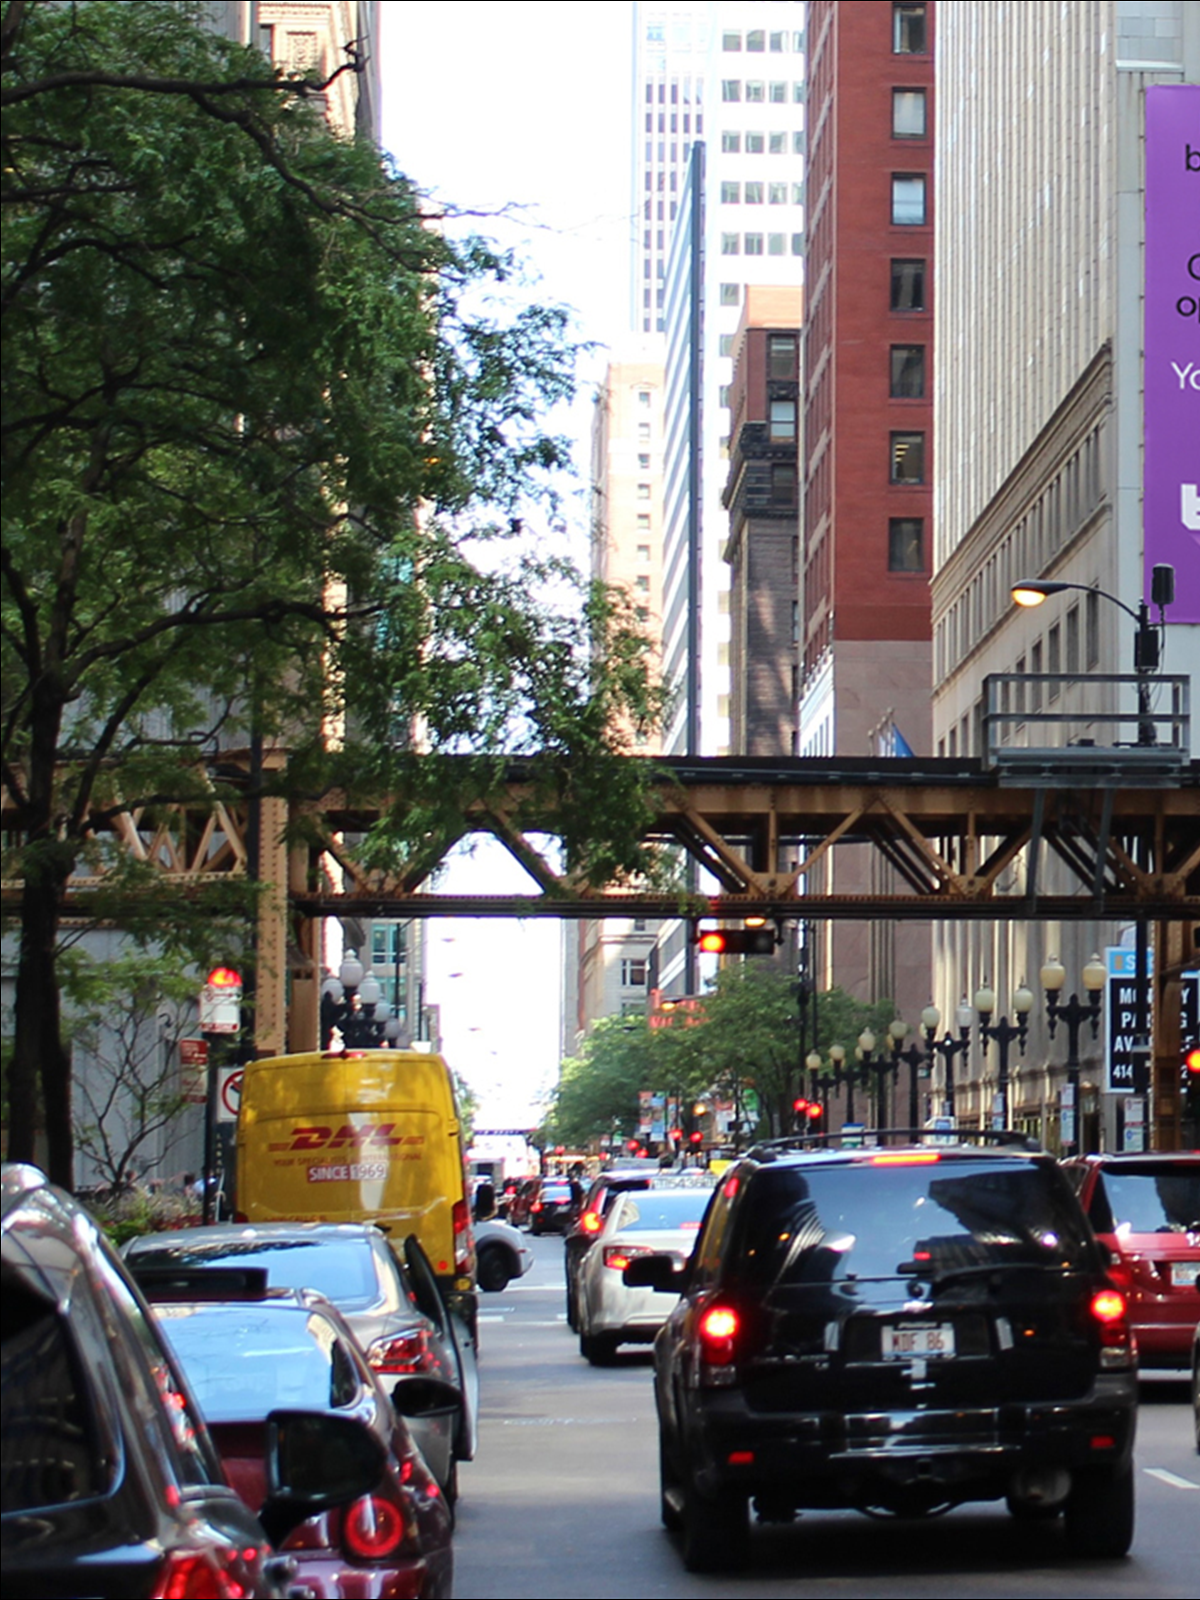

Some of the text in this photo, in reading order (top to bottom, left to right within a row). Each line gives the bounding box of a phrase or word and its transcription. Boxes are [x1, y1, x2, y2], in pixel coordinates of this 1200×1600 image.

[289, 1123, 403, 1150] DHL
[309, 1164, 386, 1181] SINCE 1969
